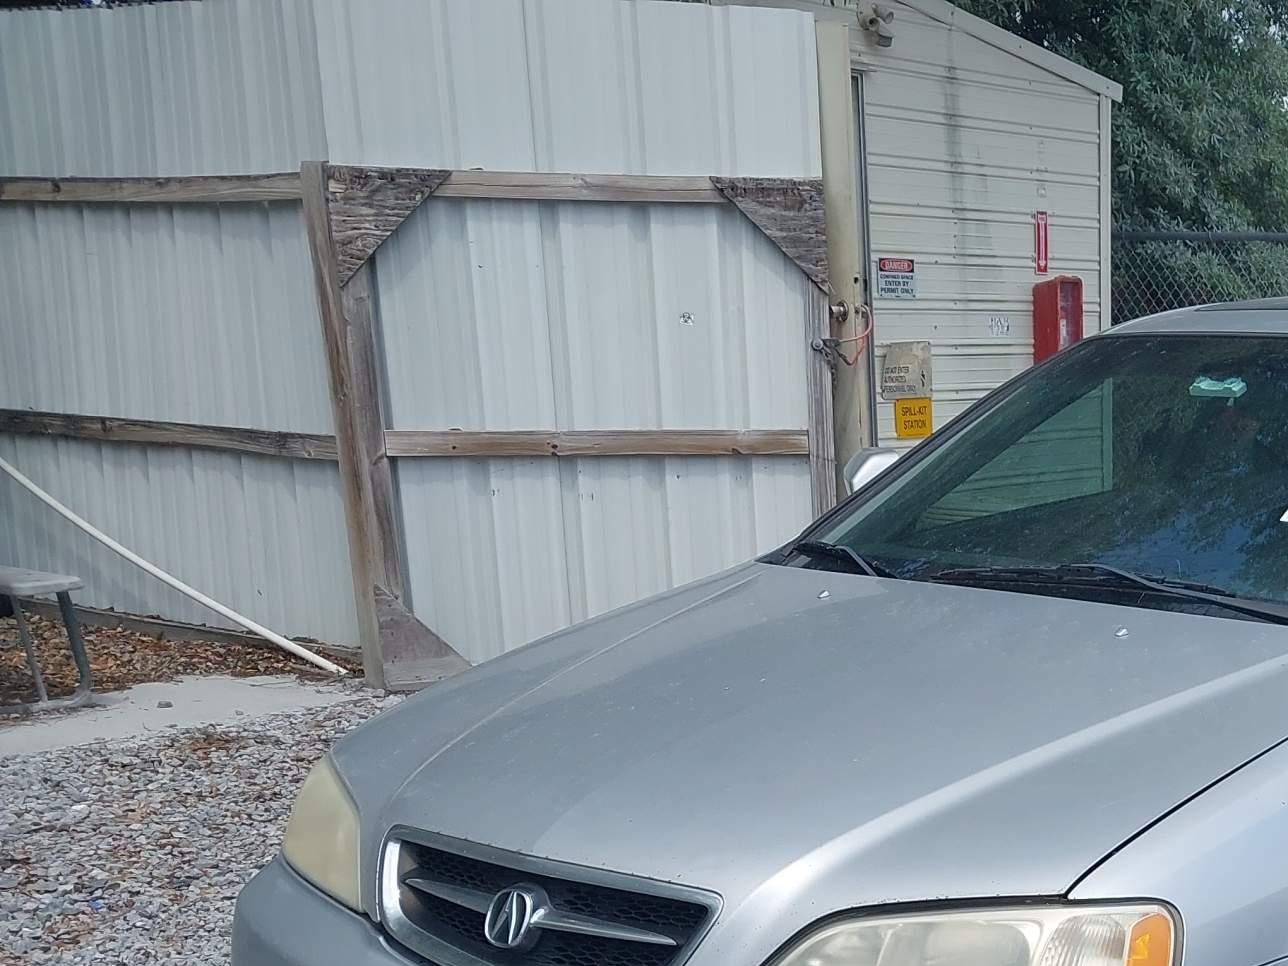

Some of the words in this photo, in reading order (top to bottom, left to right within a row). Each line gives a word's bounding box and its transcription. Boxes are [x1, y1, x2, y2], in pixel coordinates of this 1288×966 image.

[884, 261, 908, 269] DANGER
[901, 406, 927, 417] SPILL-KIT
[903, 419, 927, 430] STATION
